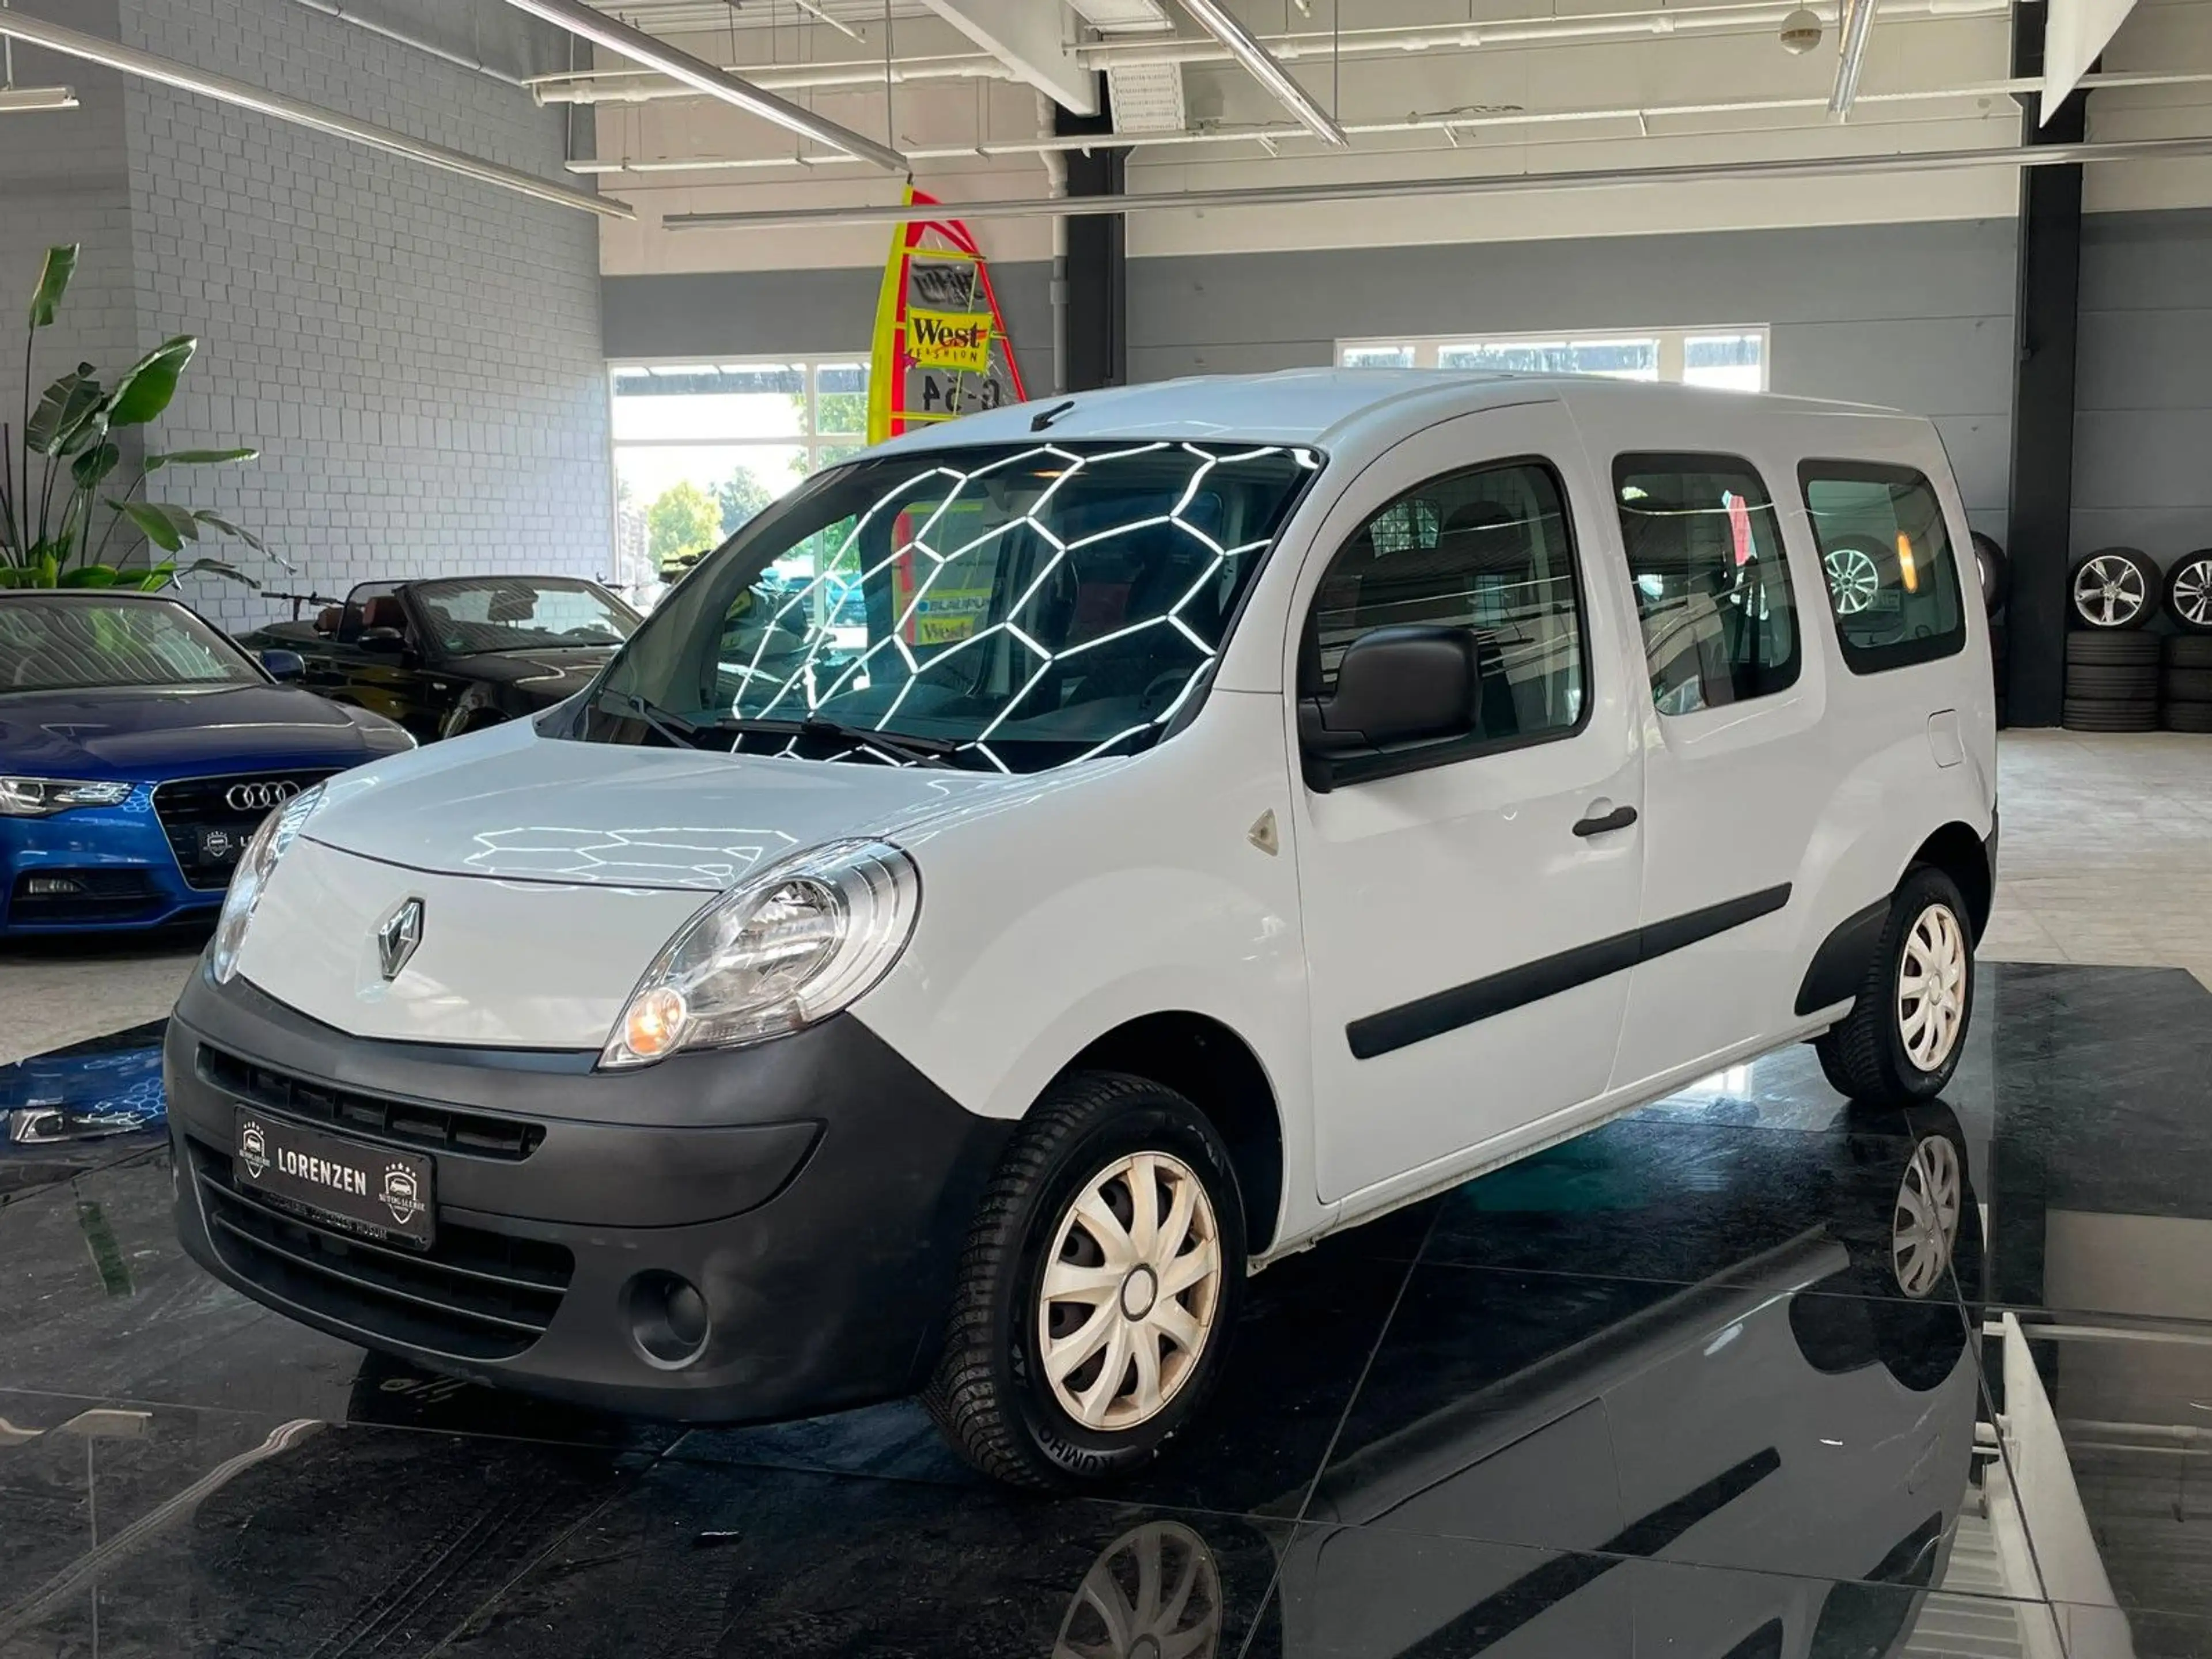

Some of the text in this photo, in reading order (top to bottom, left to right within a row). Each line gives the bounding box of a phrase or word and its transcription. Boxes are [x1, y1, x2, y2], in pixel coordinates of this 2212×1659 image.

[912, 318, 979, 349] West
[278, 1147, 366, 1196] LORENZEN
[1039, 1427, 1114, 1472] KUMHO
